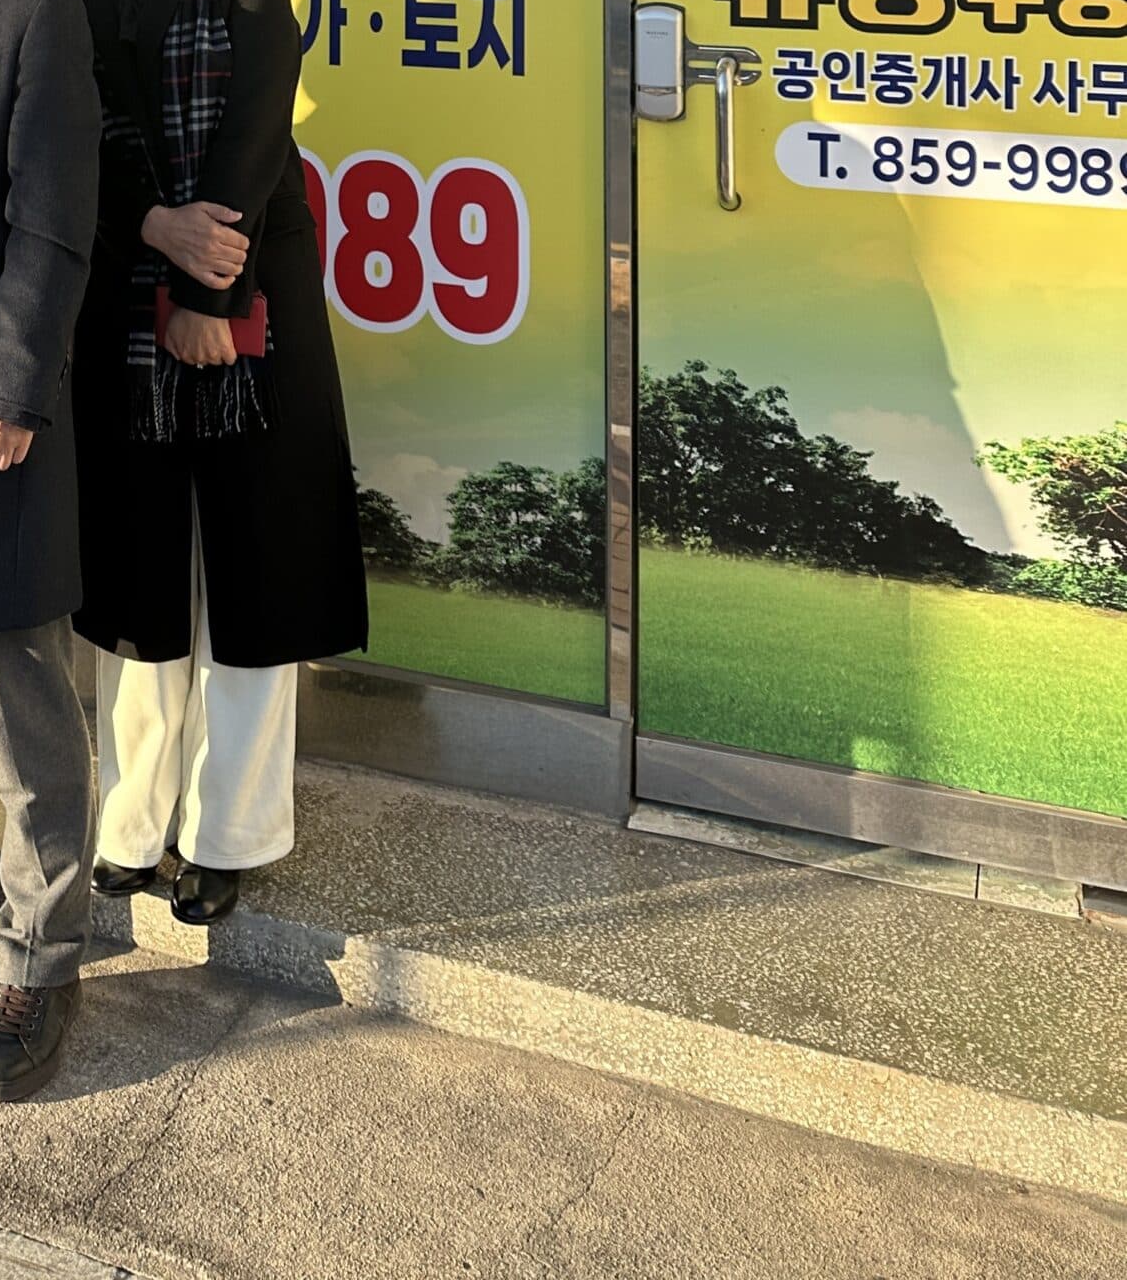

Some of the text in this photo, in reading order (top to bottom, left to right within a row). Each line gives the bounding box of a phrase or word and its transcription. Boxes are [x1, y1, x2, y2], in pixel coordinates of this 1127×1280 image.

[772, 49, 1021, 111] 공인중개사
[806, 131, 1127, 198] T. 859-998
[305, 156, 521, 336] 89
